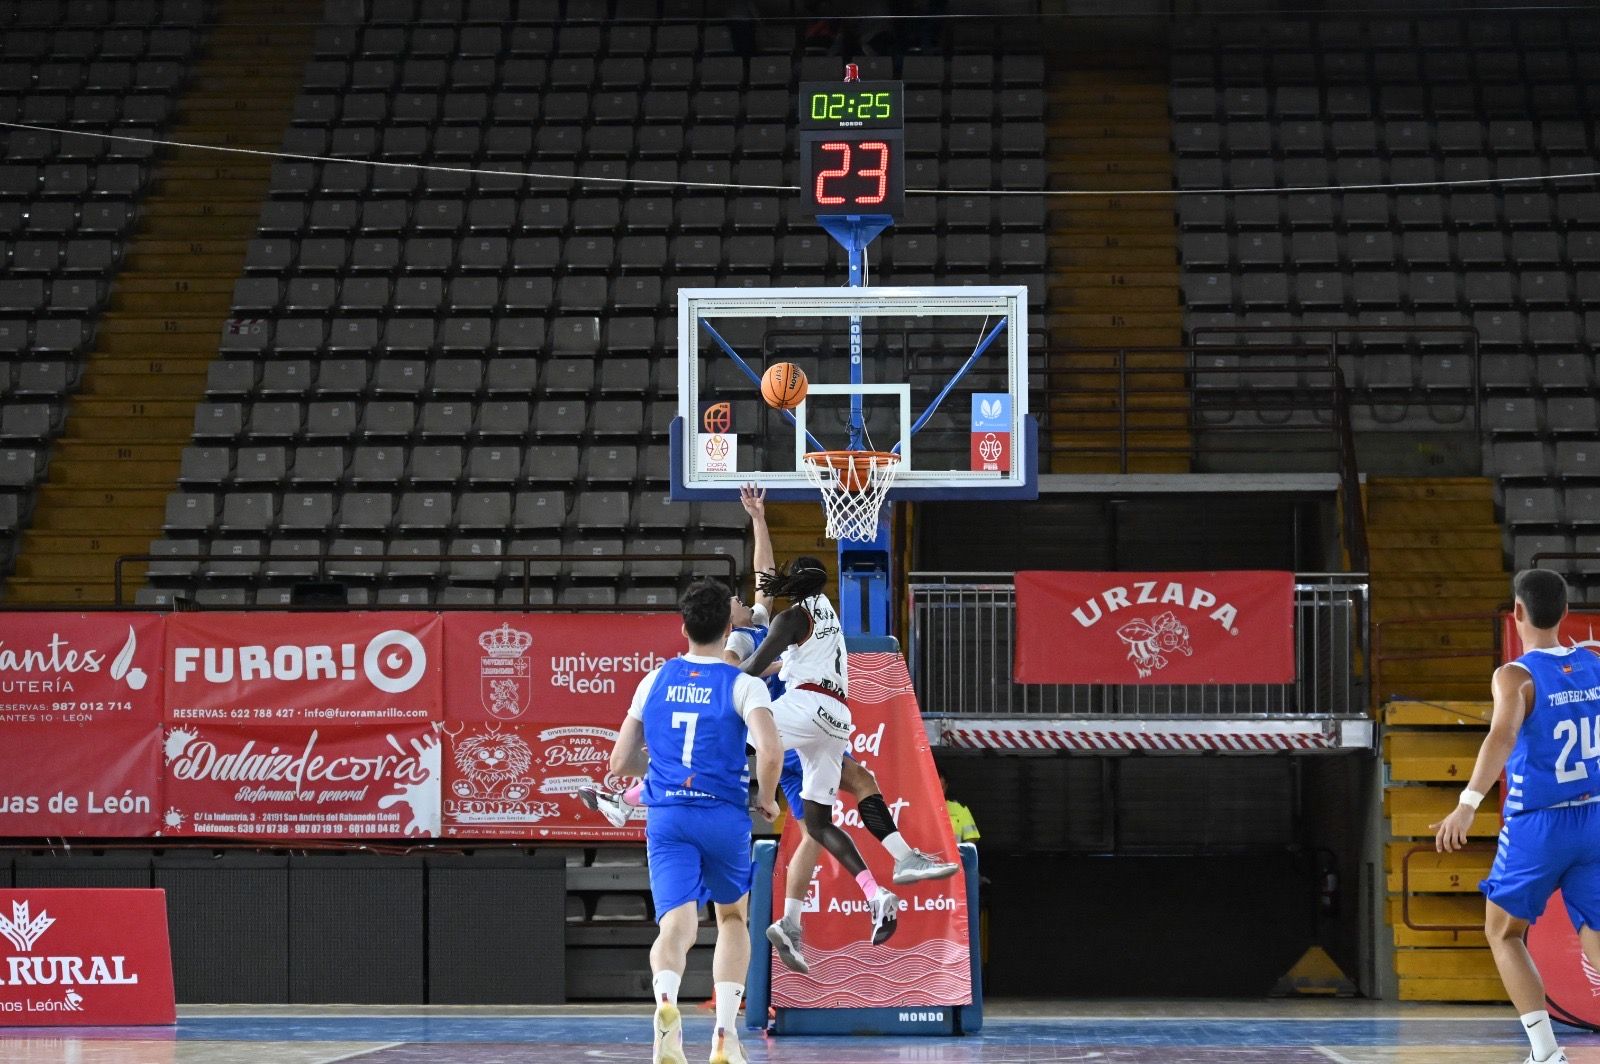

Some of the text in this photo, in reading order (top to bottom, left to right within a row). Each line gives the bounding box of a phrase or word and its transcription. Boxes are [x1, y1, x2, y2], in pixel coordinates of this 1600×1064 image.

[812, 93, 890, 119] 02:25
[816, 143, 888, 204] 23
[175, 281, 188, 291] 14
[1111, 275, 1124, 285] 14
[150, 362, 162, 372] 12
[132, 404, 144, 415] 11
[118, 448, 132, 459] 10
[105, 493, 114, 503] 9
[1071, 581, 1238, 632] URZAPA
[0, 633, 106, 673] antes
[175, 644, 355, 683] FUROR!
[552, 652, 683, 673] universida
[2, 677, 74, 693] UTERÍA
[551, 671, 615, 694] de león
[665, 683, 713, 704] MUÑOZ
[1548, 685, 1600, 707] TORREBLANC
[52, 702, 76, 711] 987
[80, 702, 104, 711] 012
[107, 702, 132, 711] 714
[173, 708, 428, 719] RESERVAS: 622 788 427 info@furoramarillo.com
[0, 714, 36, 722] ANTES
[63, 712, 93, 722] LEÓN
[547, 728, 584, 737] DIVERSIÓN
[591, 728, 614, 737] ESTILO
[671, 711, 699, 769] 7
[544, 745, 610, 767] Brillar
[1553, 715, 1600, 784] 24
[1448, 764, 1457, 777] 4
[0, 789, 150, 814] uas de León
[234, 785, 369, 804] Reformas en general
[444, 799, 561, 817] LEONPARK
[194, 812, 203, 821] C/
[204, 813, 212, 821] La
[250, 813, 255, 821] 3
[262, 813, 283, 822] 24191
[284, 813, 298, 821] San
[299, 813, 325, 821] Andrés
[326, 813, 338, 821] del
[194, 823, 236, 833] Teléfonos:
[255, 824, 265, 833] 97
[1450, 875, 1460, 887] 2
[828, 897, 872, 914] Agua
[914, 895, 956, 911] León
[6, 955, 138, 986] RURAL
[27, 999, 64, 1012] León
[899, 1012, 944, 1022] MONDO
